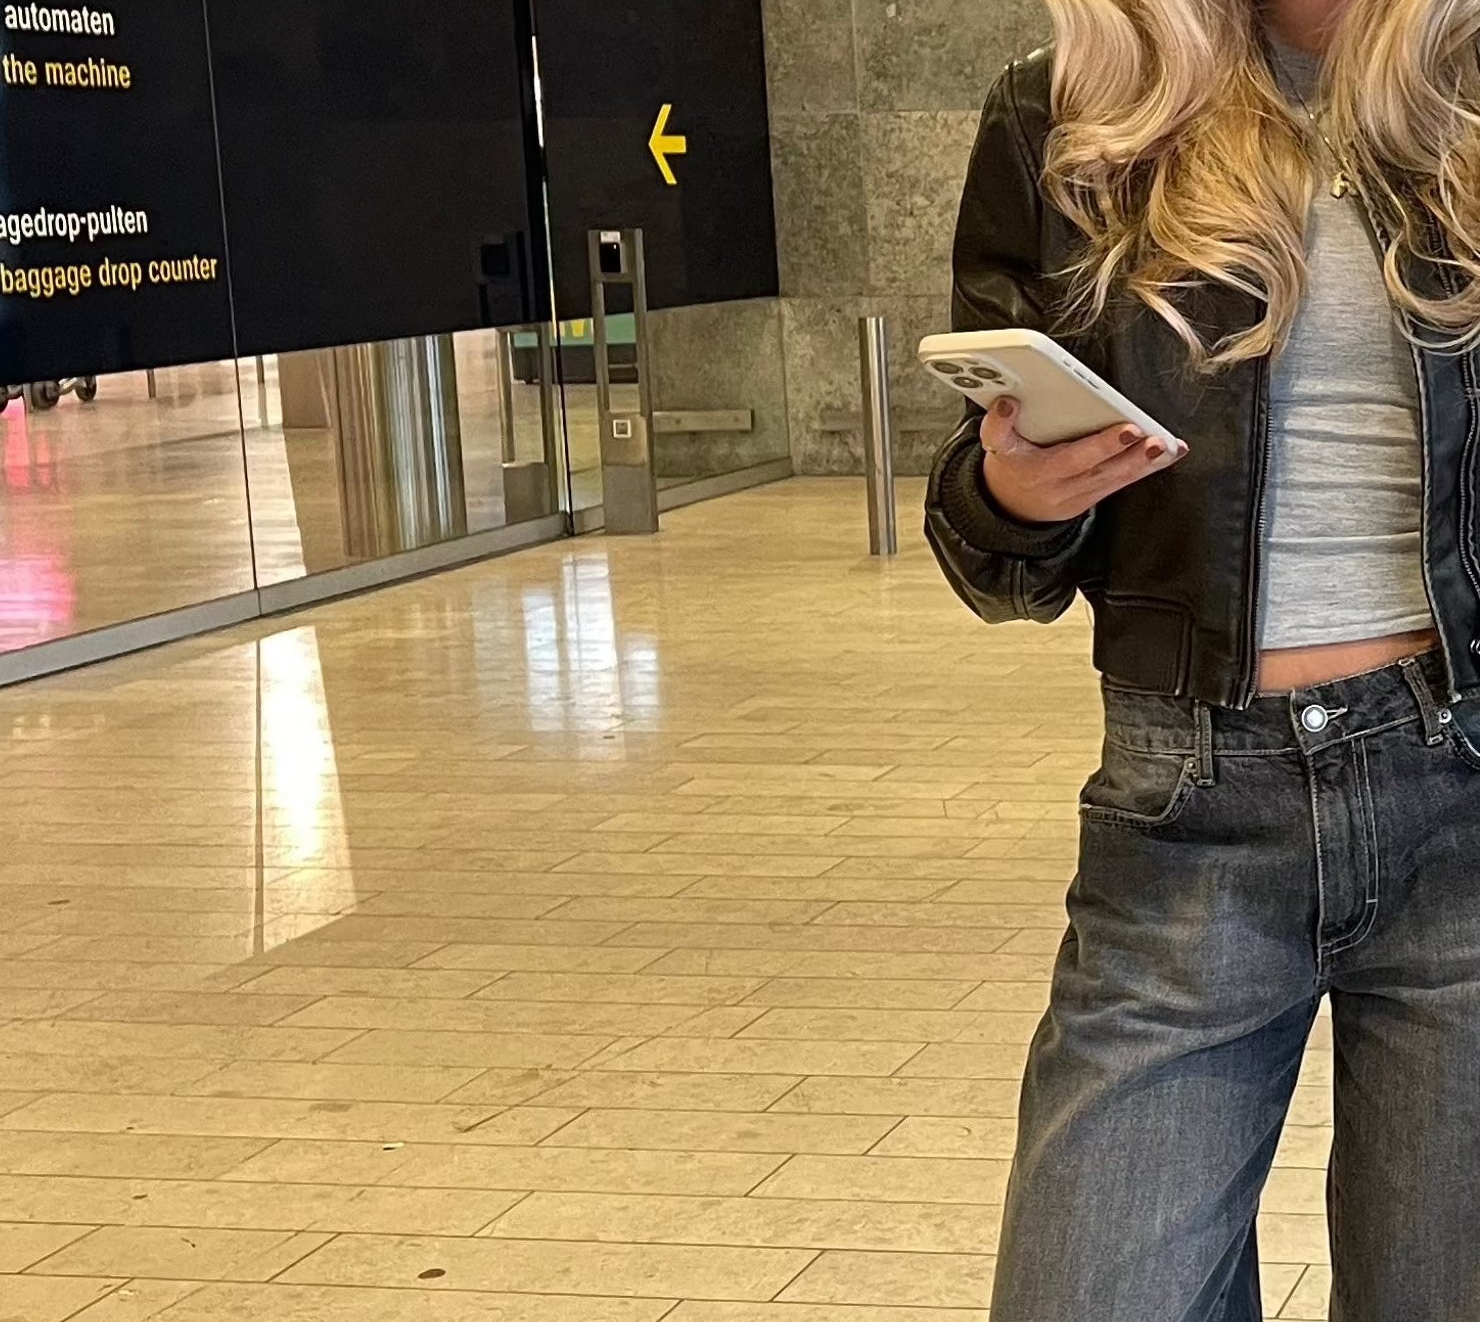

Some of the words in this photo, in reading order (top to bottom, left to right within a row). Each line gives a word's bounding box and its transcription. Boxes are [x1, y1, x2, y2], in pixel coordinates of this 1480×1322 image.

[4, 2, 115, 36] automaten
[2, 53, 38, 85] the
[45, 57, 131, 89] machine
[0, 262, 92, 298] baggage
[98, 256, 142, 291] drop
[148, 254, 218, 283] counter
